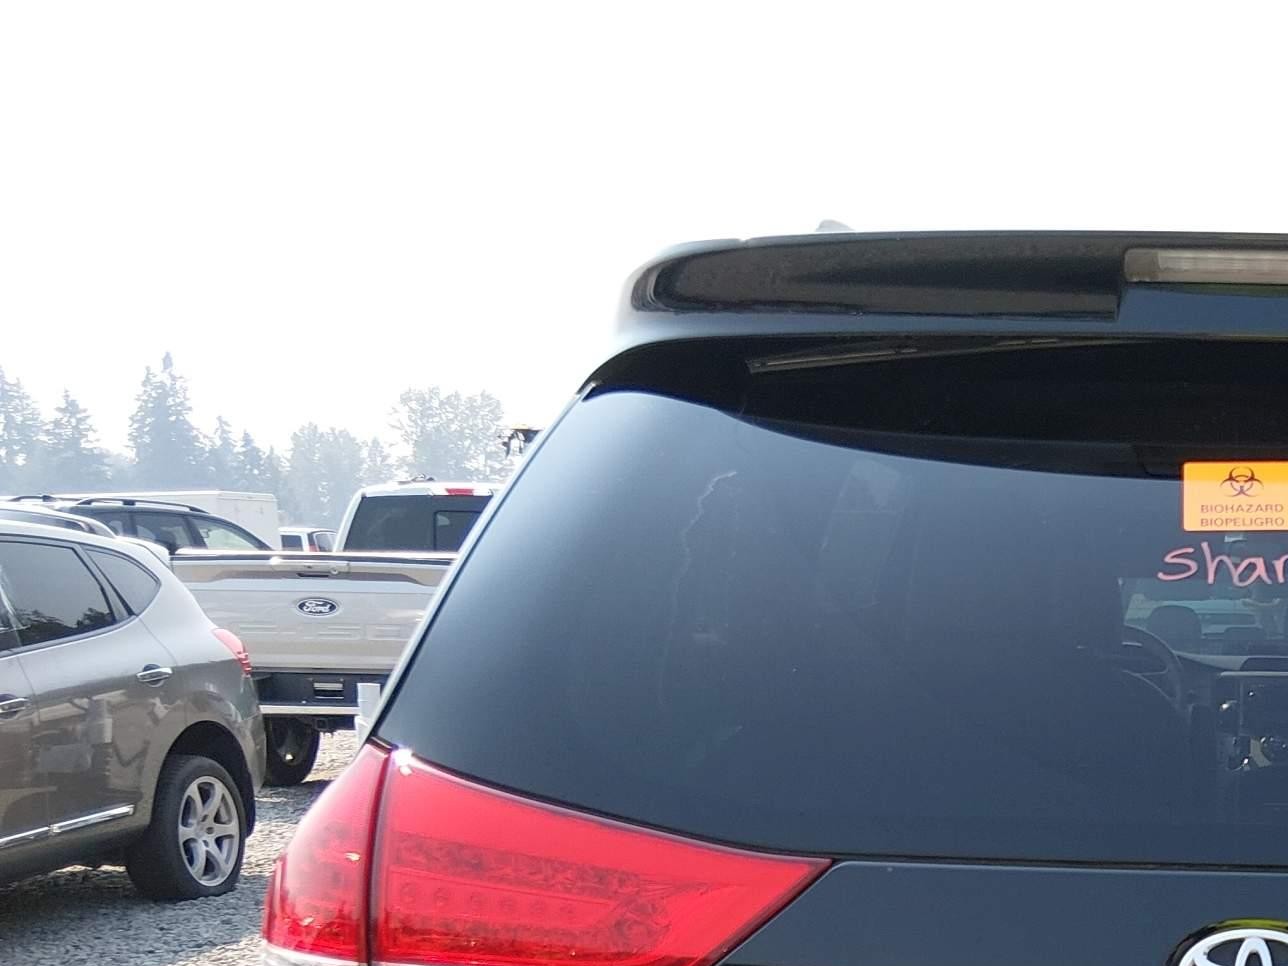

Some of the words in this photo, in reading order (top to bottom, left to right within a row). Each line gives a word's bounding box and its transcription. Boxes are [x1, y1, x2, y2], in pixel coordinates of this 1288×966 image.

[1200, 503, 1285, 514] BIOHAZARD
[1200, 517, 1286, 528] BIOPELIGRO
[302, 600, 331, 613] Ford
